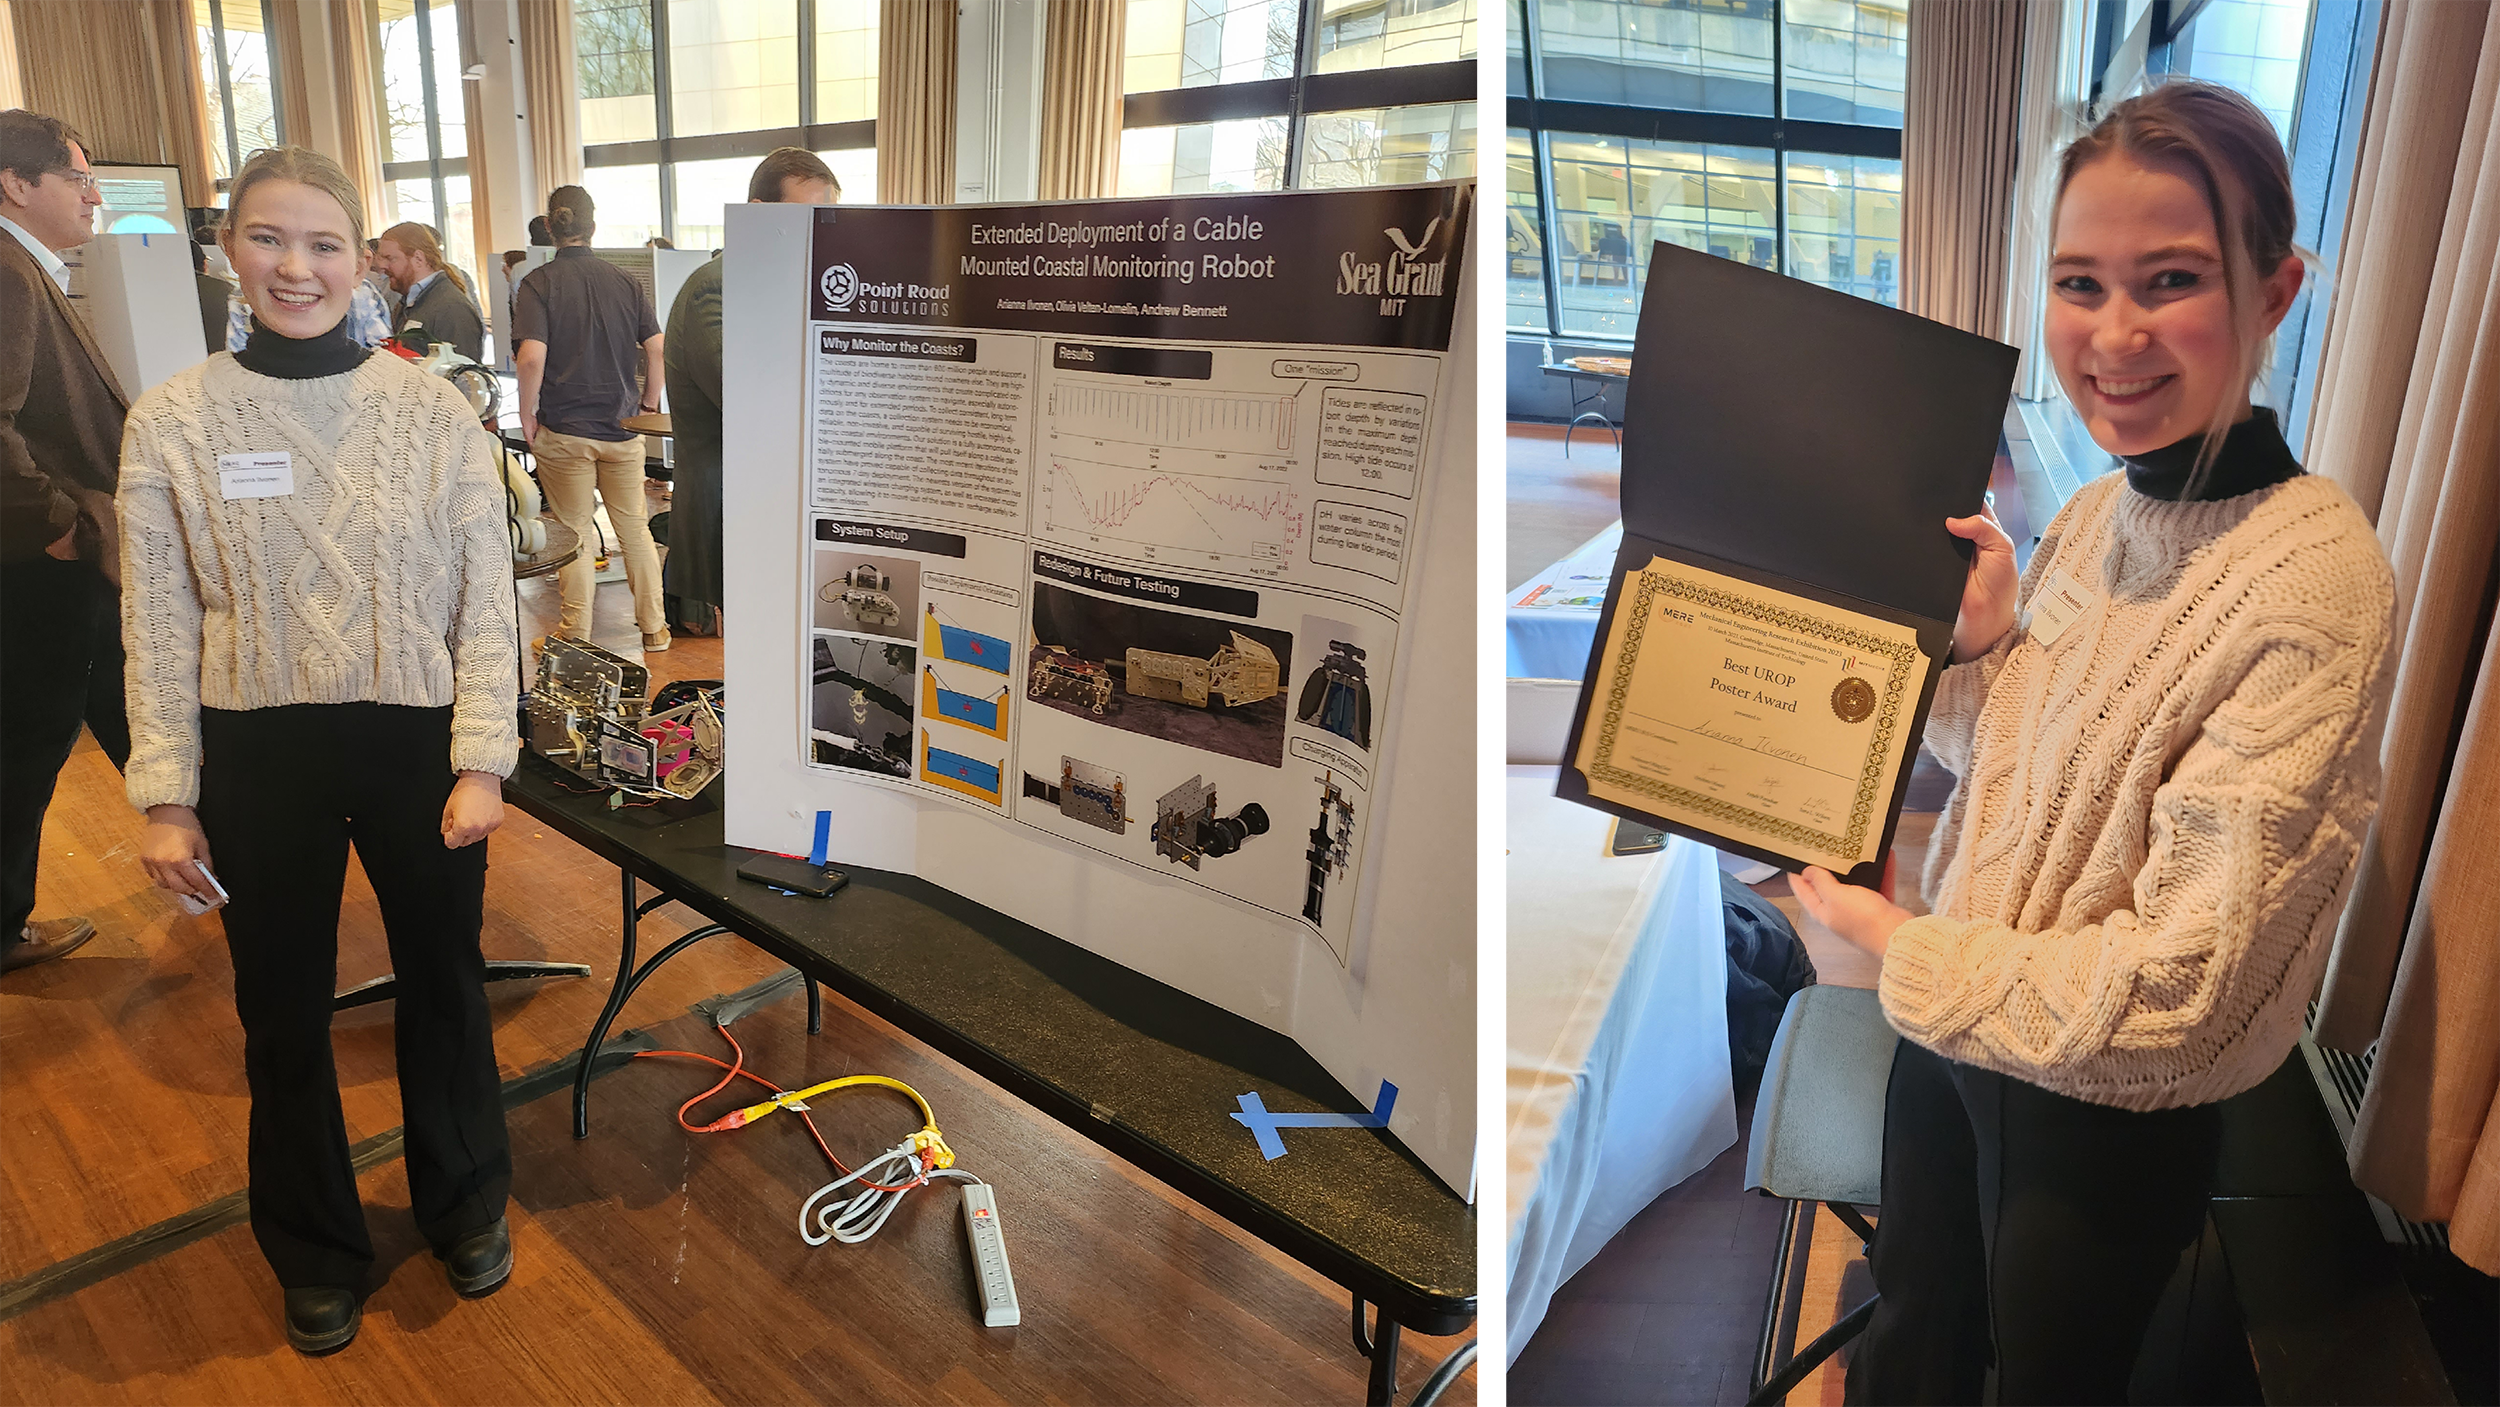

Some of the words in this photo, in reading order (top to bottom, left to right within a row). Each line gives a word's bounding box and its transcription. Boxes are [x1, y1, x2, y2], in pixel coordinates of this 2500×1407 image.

[971, 222, 1044, 245] Extended
[1047, 220, 1144, 248] Deployment
[1148, 217, 1170, 242] of
[1173, 223, 1187, 242] a
[1193, 215, 1264, 242] Cable
[960, 254, 1030, 276] Mounted
[1033, 255, 1089, 277] Coastal
[1092, 254, 1195, 284] Monitoring
[1202, 253, 1276, 278] Robot
[1336, 251, 1382, 296] Sea
[1386, 251, 1448, 297] Grant
[859, 281, 904, 300] Point
[907, 284, 950, 300] Road
[1056, 299, 1077, 312] Olivia
[1140, 303, 1181, 317] Andrew
[1181, 304, 1228, 317] Bennett
[1380, 298, 1407, 317] MIT
[822, 337, 850, 352] Why
[851, 338, 898, 352] Monitor
[899, 341, 919, 353] the
[920, 342, 965, 356] Coasts?
[1059, 346, 1095, 362] Results
[819, 357, 832, 365] The
[968, 367, 988, 375] people
[988, 369, 999, 377] and
[1284, 364, 1304, 374] One
[827, 379, 857, 388] dynamic
[857, 380, 870, 388] and
[897, 382, 941, 393] environments
[974, 389, 1009, 399] complicated
[861, 371, 896, 379] biodiverse
[985, 378, 999, 388] They
[1328, 397, 1351, 409] Tides
[1353, 401, 1367, 410] are
[1369, 401, 1404, 414] reflected
[1405, 405, 1413, 414] in
[1326, 411, 1341, 421] bot
[1345, 413, 1370, 425] depth
[1374, 415, 1385, 427] by
[1388, 417, 1420, 431] variations
[1325, 423, 1333, 433] in
[1338, 425, 1353, 435] the
[1358, 428, 1397, 440] maximum
[1400, 433, 1418, 445] depth
[1323, 437, 1359, 450] reached
[1359, 441, 1385, 455] during
[1385, 444, 1402, 455] each
[1322, 450, 1342, 461] sion.
[1345, 452, 1365, 465] High
[1367, 455, 1382, 466] tide
[1384, 459, 1407, 471] occurs
[1361, 468, 1383, 480] 12:00.
[1319, 510, 1333, 520] pH
[1338, 513, 1363, 525] varies
[1367, 518, 1390, 531] across
[1393, 523, 1403, 535] the
[832, 523, 874, 539] System
[875, 527, 909, 543] Setup
[1318, 523, 1342, 534] water
[1344, 526, 1374, 540] column
[1374, 532, 1386, 543] the
[1386, 536, 1401, 548] most
[1317, 535, 1345, 549] during
[1345, 538, 1360, 550] low
[1361, 542, 1376, 554] tide
[1375, 547, 1399, 561] periods.
[926, 573, 949, 585] Possible
[1038, 555, 1082, 579] Redesign
[1083, 565, 1092, 580] &
[1093, 568, 1131, 588] Future
[1133, 576, 1180, 598] Testing
[1249, 567, 1259, 575] Aug
[2060, 589, 2084, 610] Presenter
[1663, 607, 1695, 624] MERE
[1699, 611, 1733, 627] Mechanical
[1732, 620, 1767, 638] Engineering
[1768, 630, 1795, 644] Research
[1795, 638, 1827, 653] Exhibition
[1827, 647, 1843, 657] 2023
[1713, 627, 1728, 636] March
[1798, 651, 1814, 661] United
[1814, 656, 1829, 665] States
[1725, 637, 1757, 651] Massachusetts
[1781, 653, 1806, 667] Technology
[1723, 656, 1751, 676] Best
[1753, 665, 1797, 688] UROP
[1710, 677, 1751, 701] Poster
[1752, 690, 1798, 713] Award
[1734, 709, 1756, 721] presented
[1302, 742, 1336, 762] Charging
